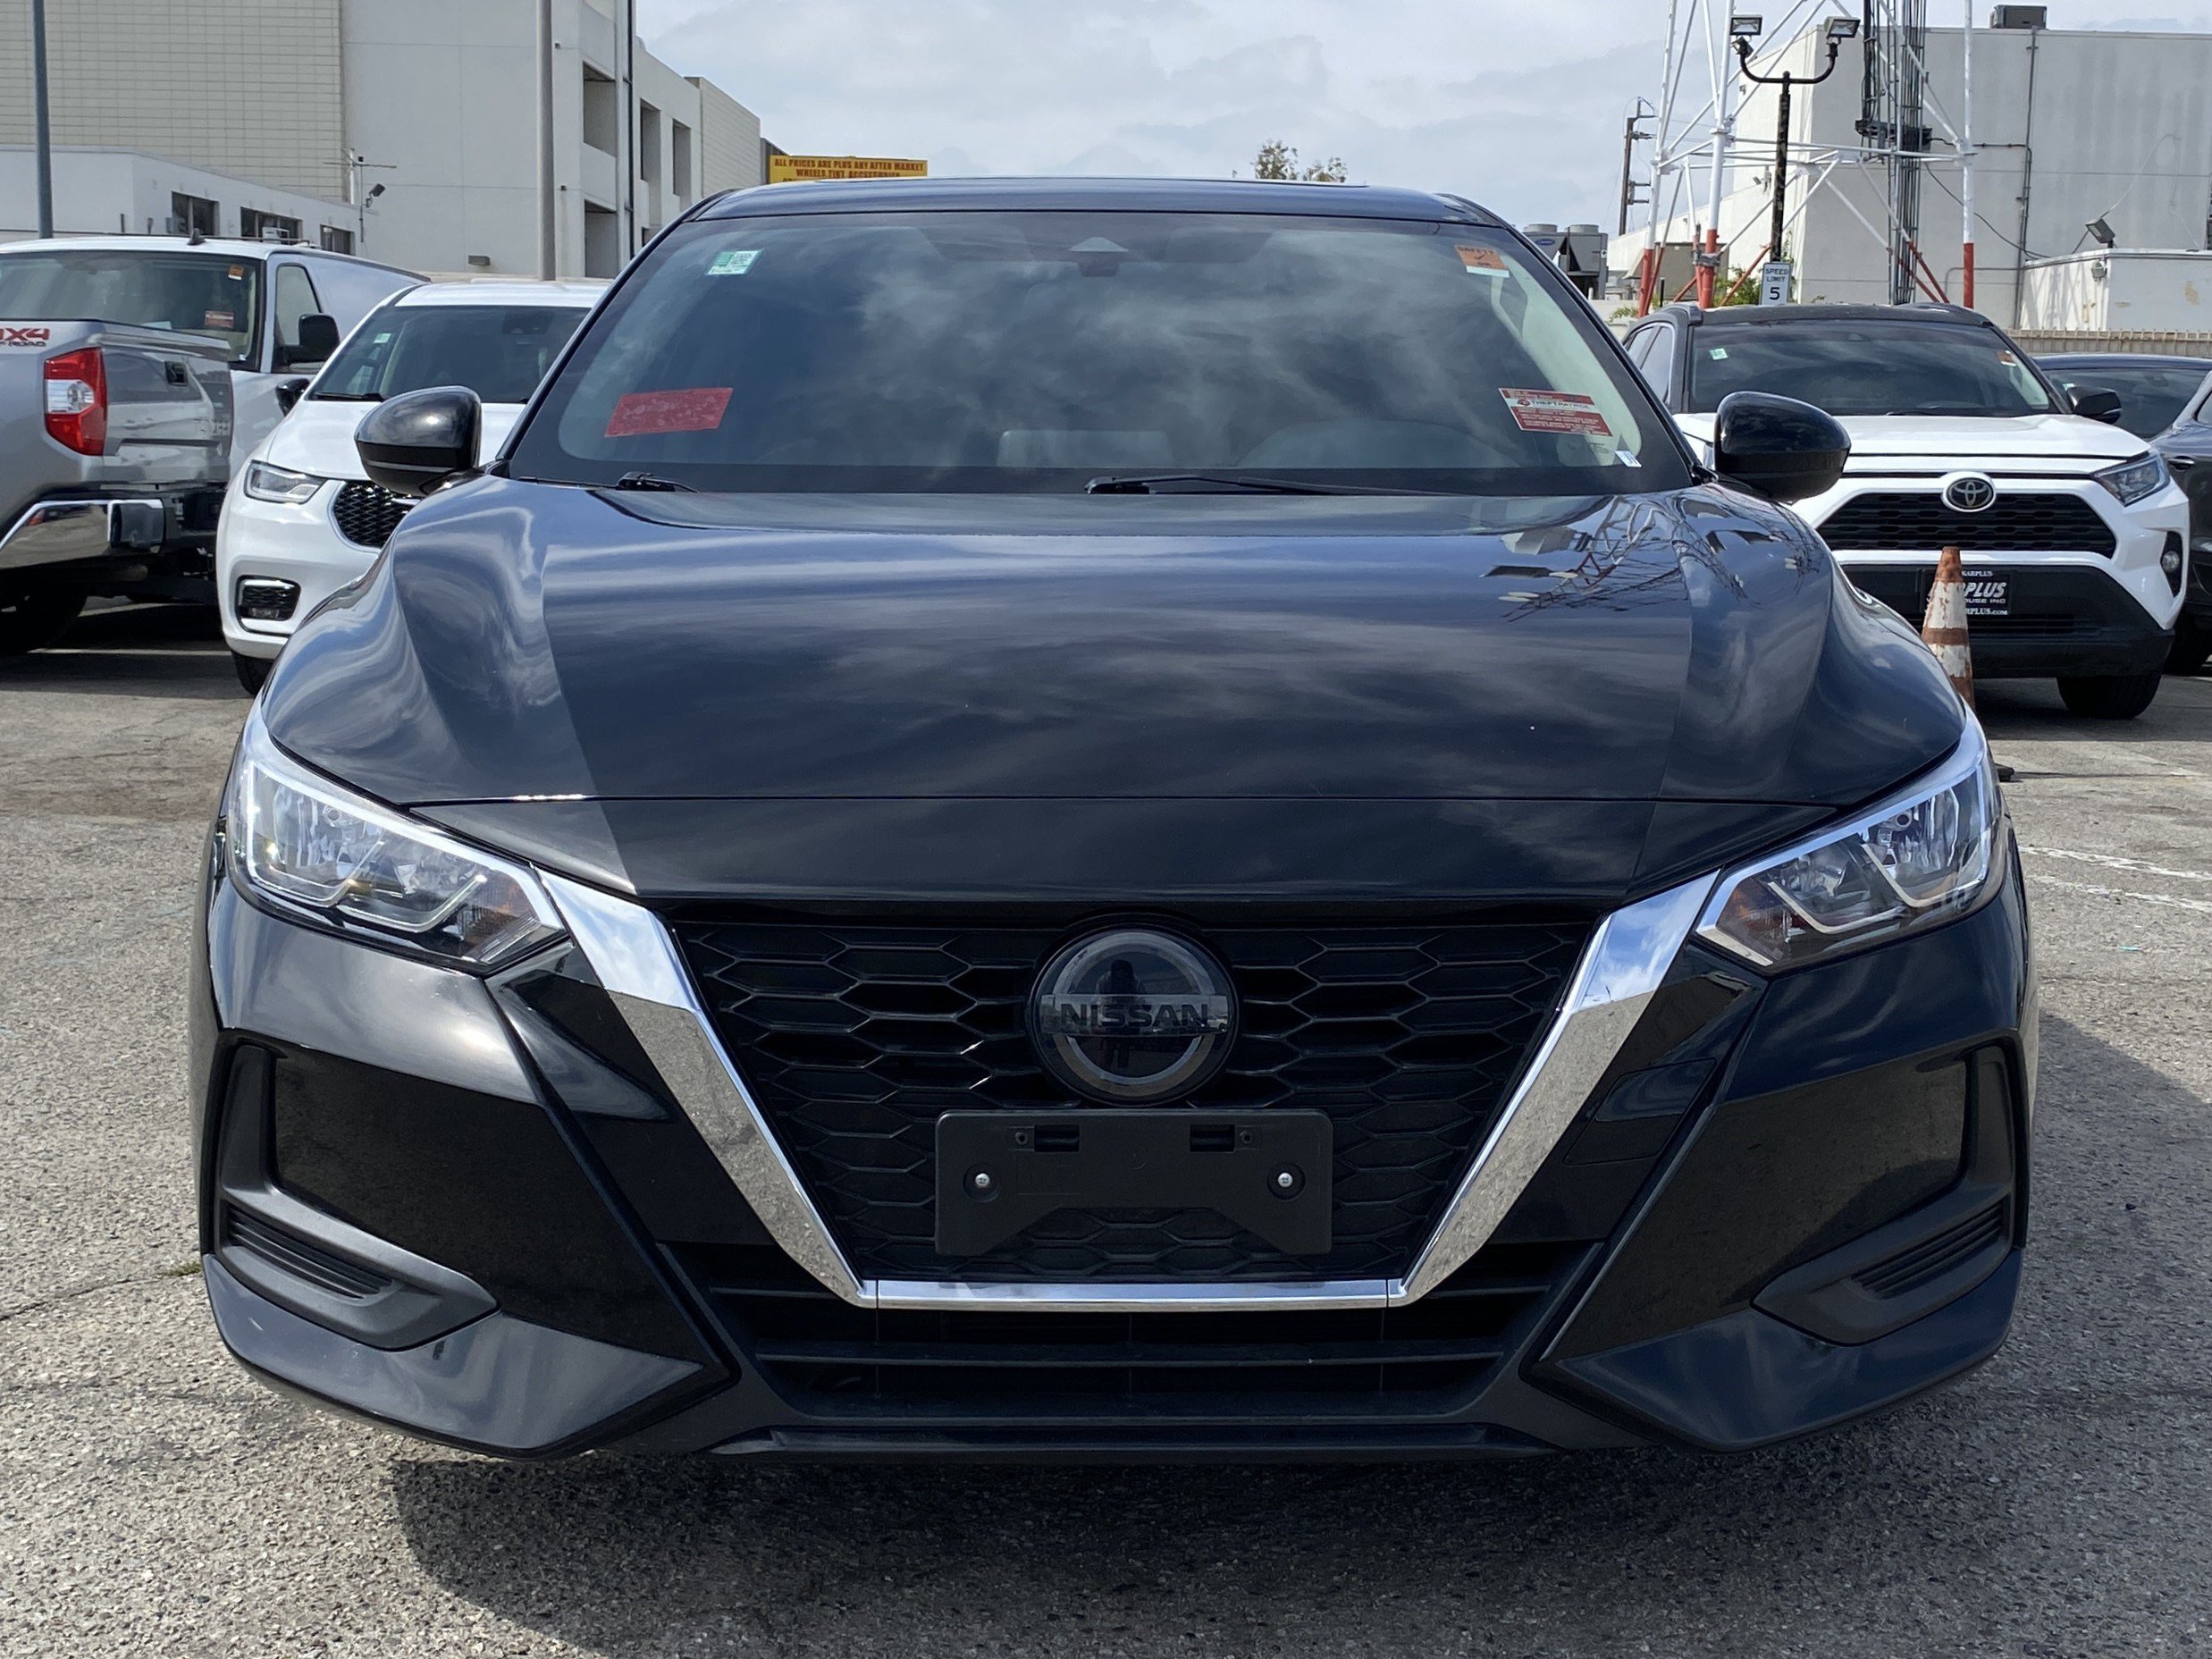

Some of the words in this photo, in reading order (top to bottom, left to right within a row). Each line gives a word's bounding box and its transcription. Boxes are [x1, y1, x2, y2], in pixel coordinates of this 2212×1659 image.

[774, 158, 786, 167] ALL
[789, 159, 816, 168] PRICES
[818, 160, 831, 168] ARE
[833, 161, 852, 169] PLUS
[854, 161, 868, 170] ANY
[869, 162, 892, 170] AFTER
[894, 163, 924, 171] MARKET
[1769, 286, 1780, 300] 5
[1060, 1002, 1209, 1029] NISSAN
